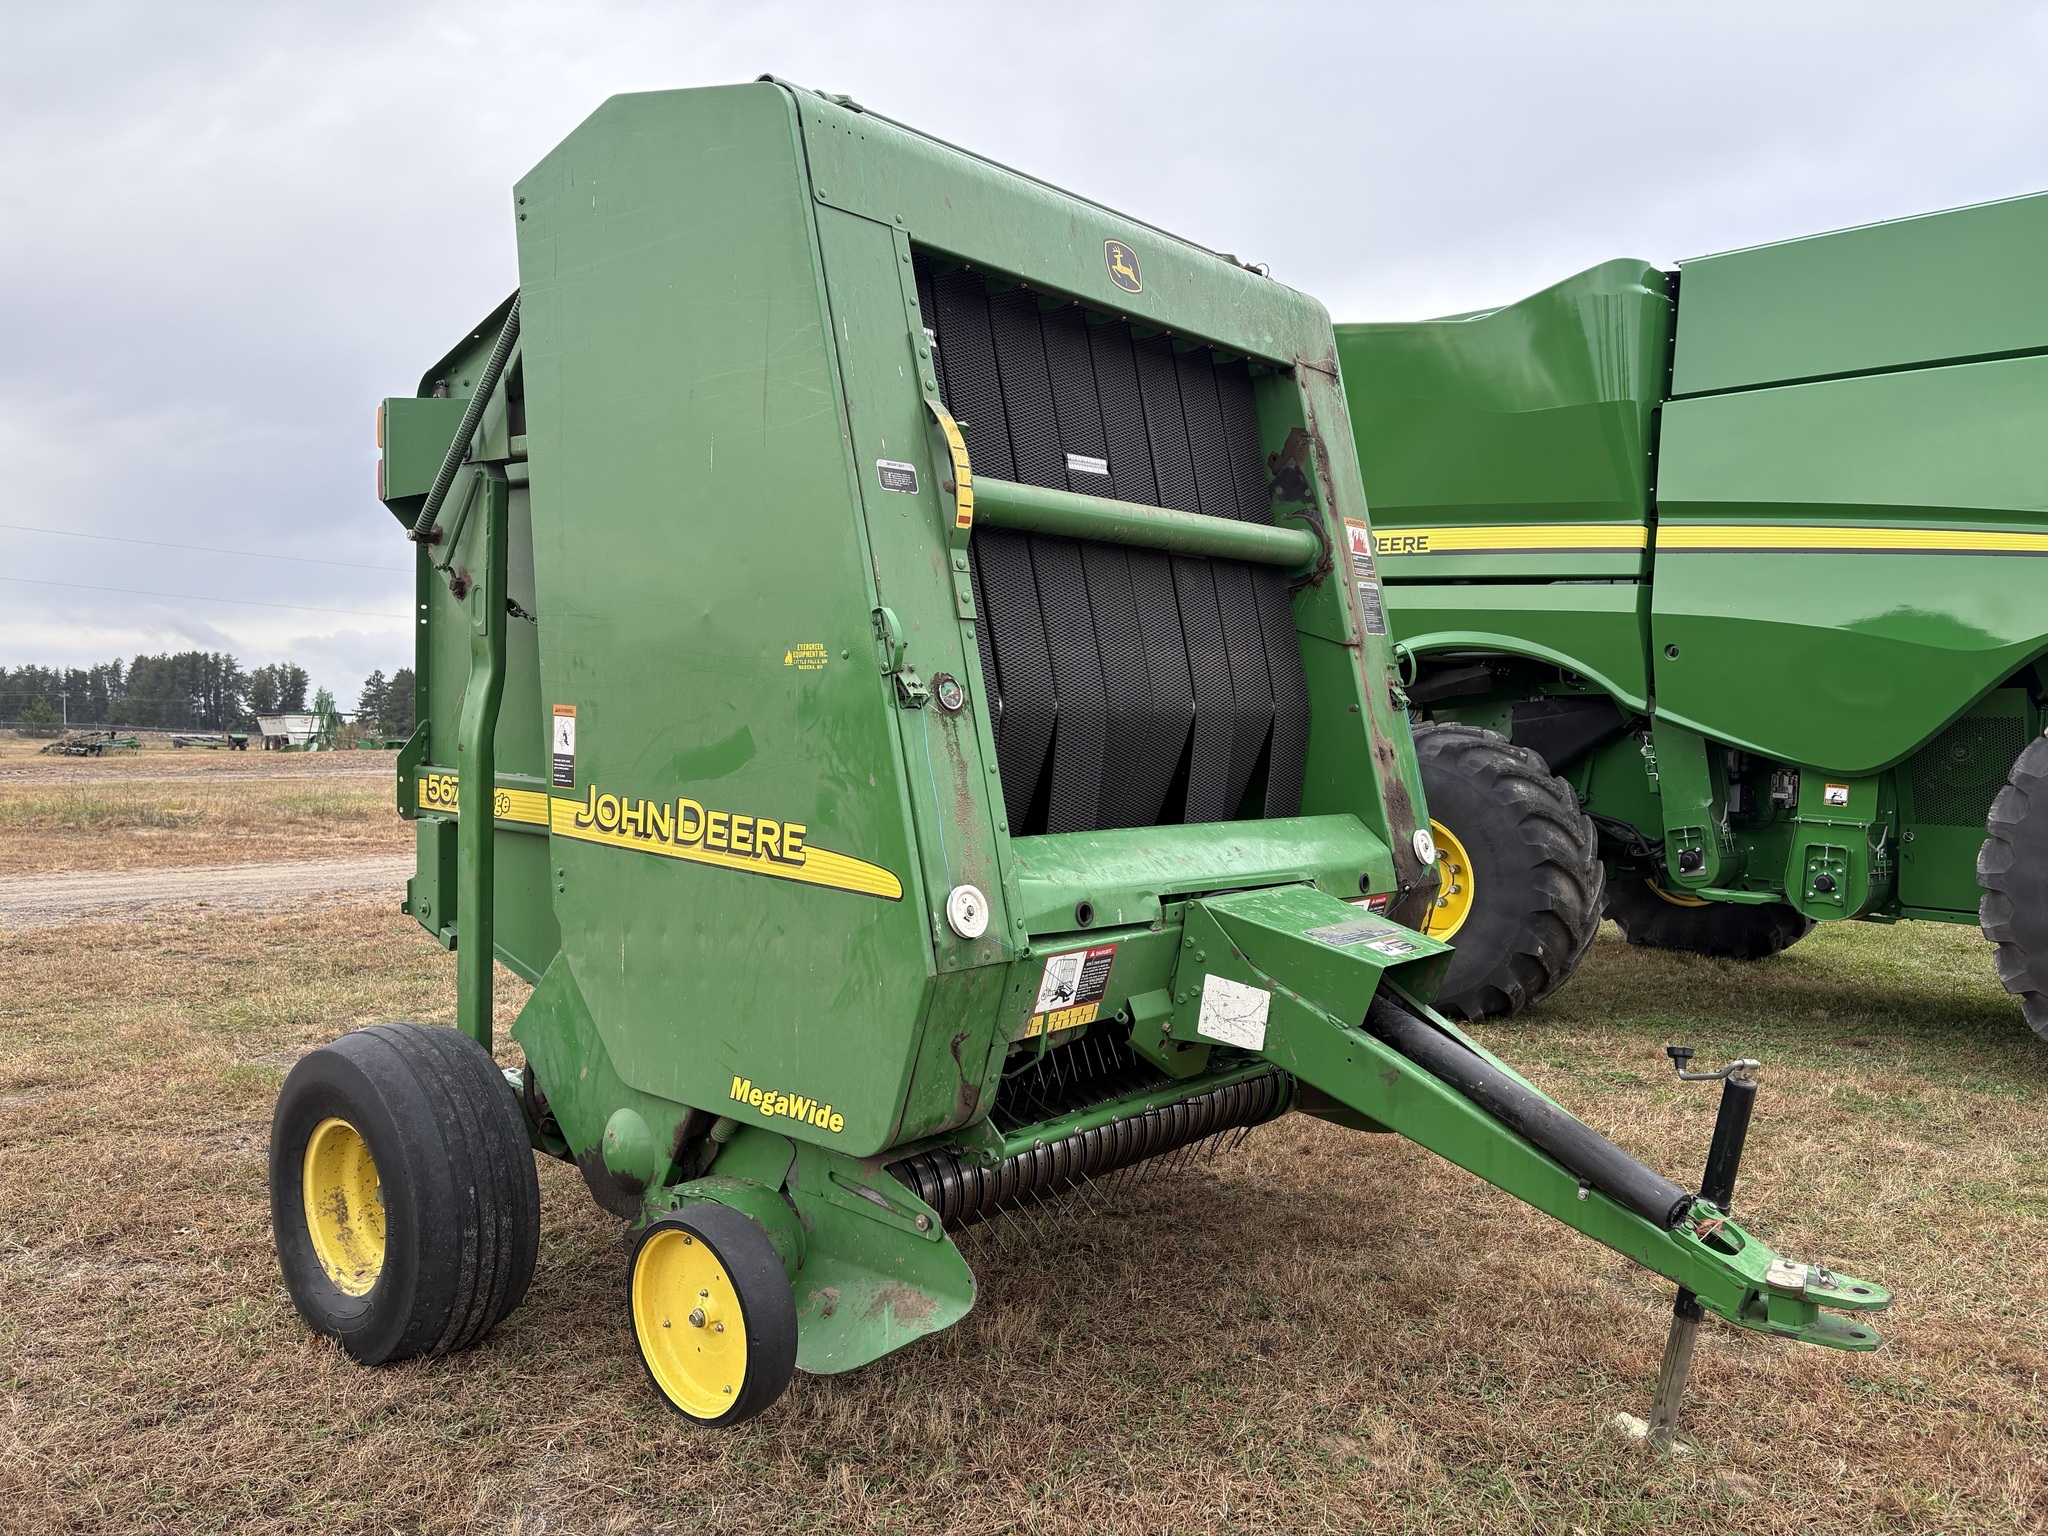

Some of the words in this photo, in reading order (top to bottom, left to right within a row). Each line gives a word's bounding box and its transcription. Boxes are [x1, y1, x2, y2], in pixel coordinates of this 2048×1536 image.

[1373, 536, 1429, 551] EERE
[575, 784, 671, 842] JOHN
[674, 796, 807, 866] DEERE
[729, 1075, 845, 1133] MegaWide
